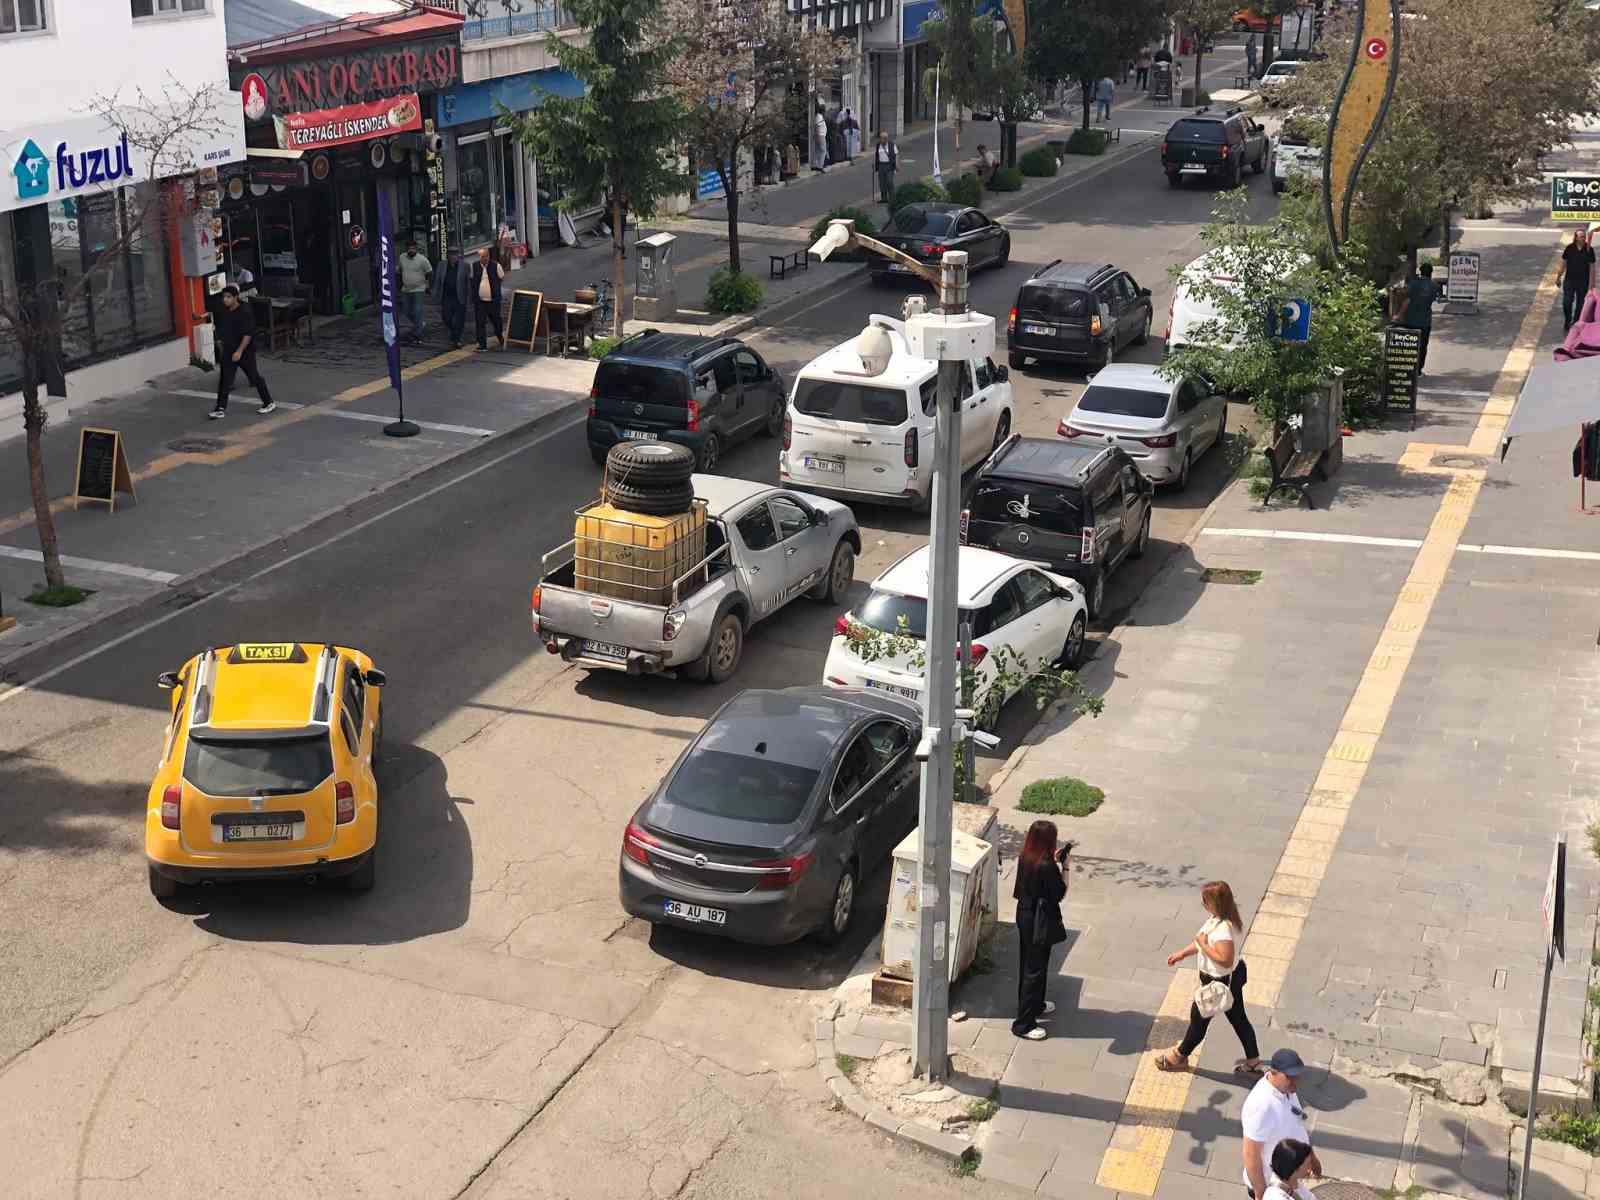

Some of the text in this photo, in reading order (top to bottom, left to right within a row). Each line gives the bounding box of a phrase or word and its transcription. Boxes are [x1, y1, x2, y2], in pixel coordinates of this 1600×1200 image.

[329, 47, 458, 98] OCAKBAŞI
[290, 115, 388, 145] TEREYAĞLI İSKENDER
[56, 132, 133, 190] fuzul
[1567, 181, 1600, 195] BeyC
[248, 645, 287, 659] TAKSİ
[230, 824, 290, 838] 36 T 0277
[668, 902, 726, 922] 36 AU 187
